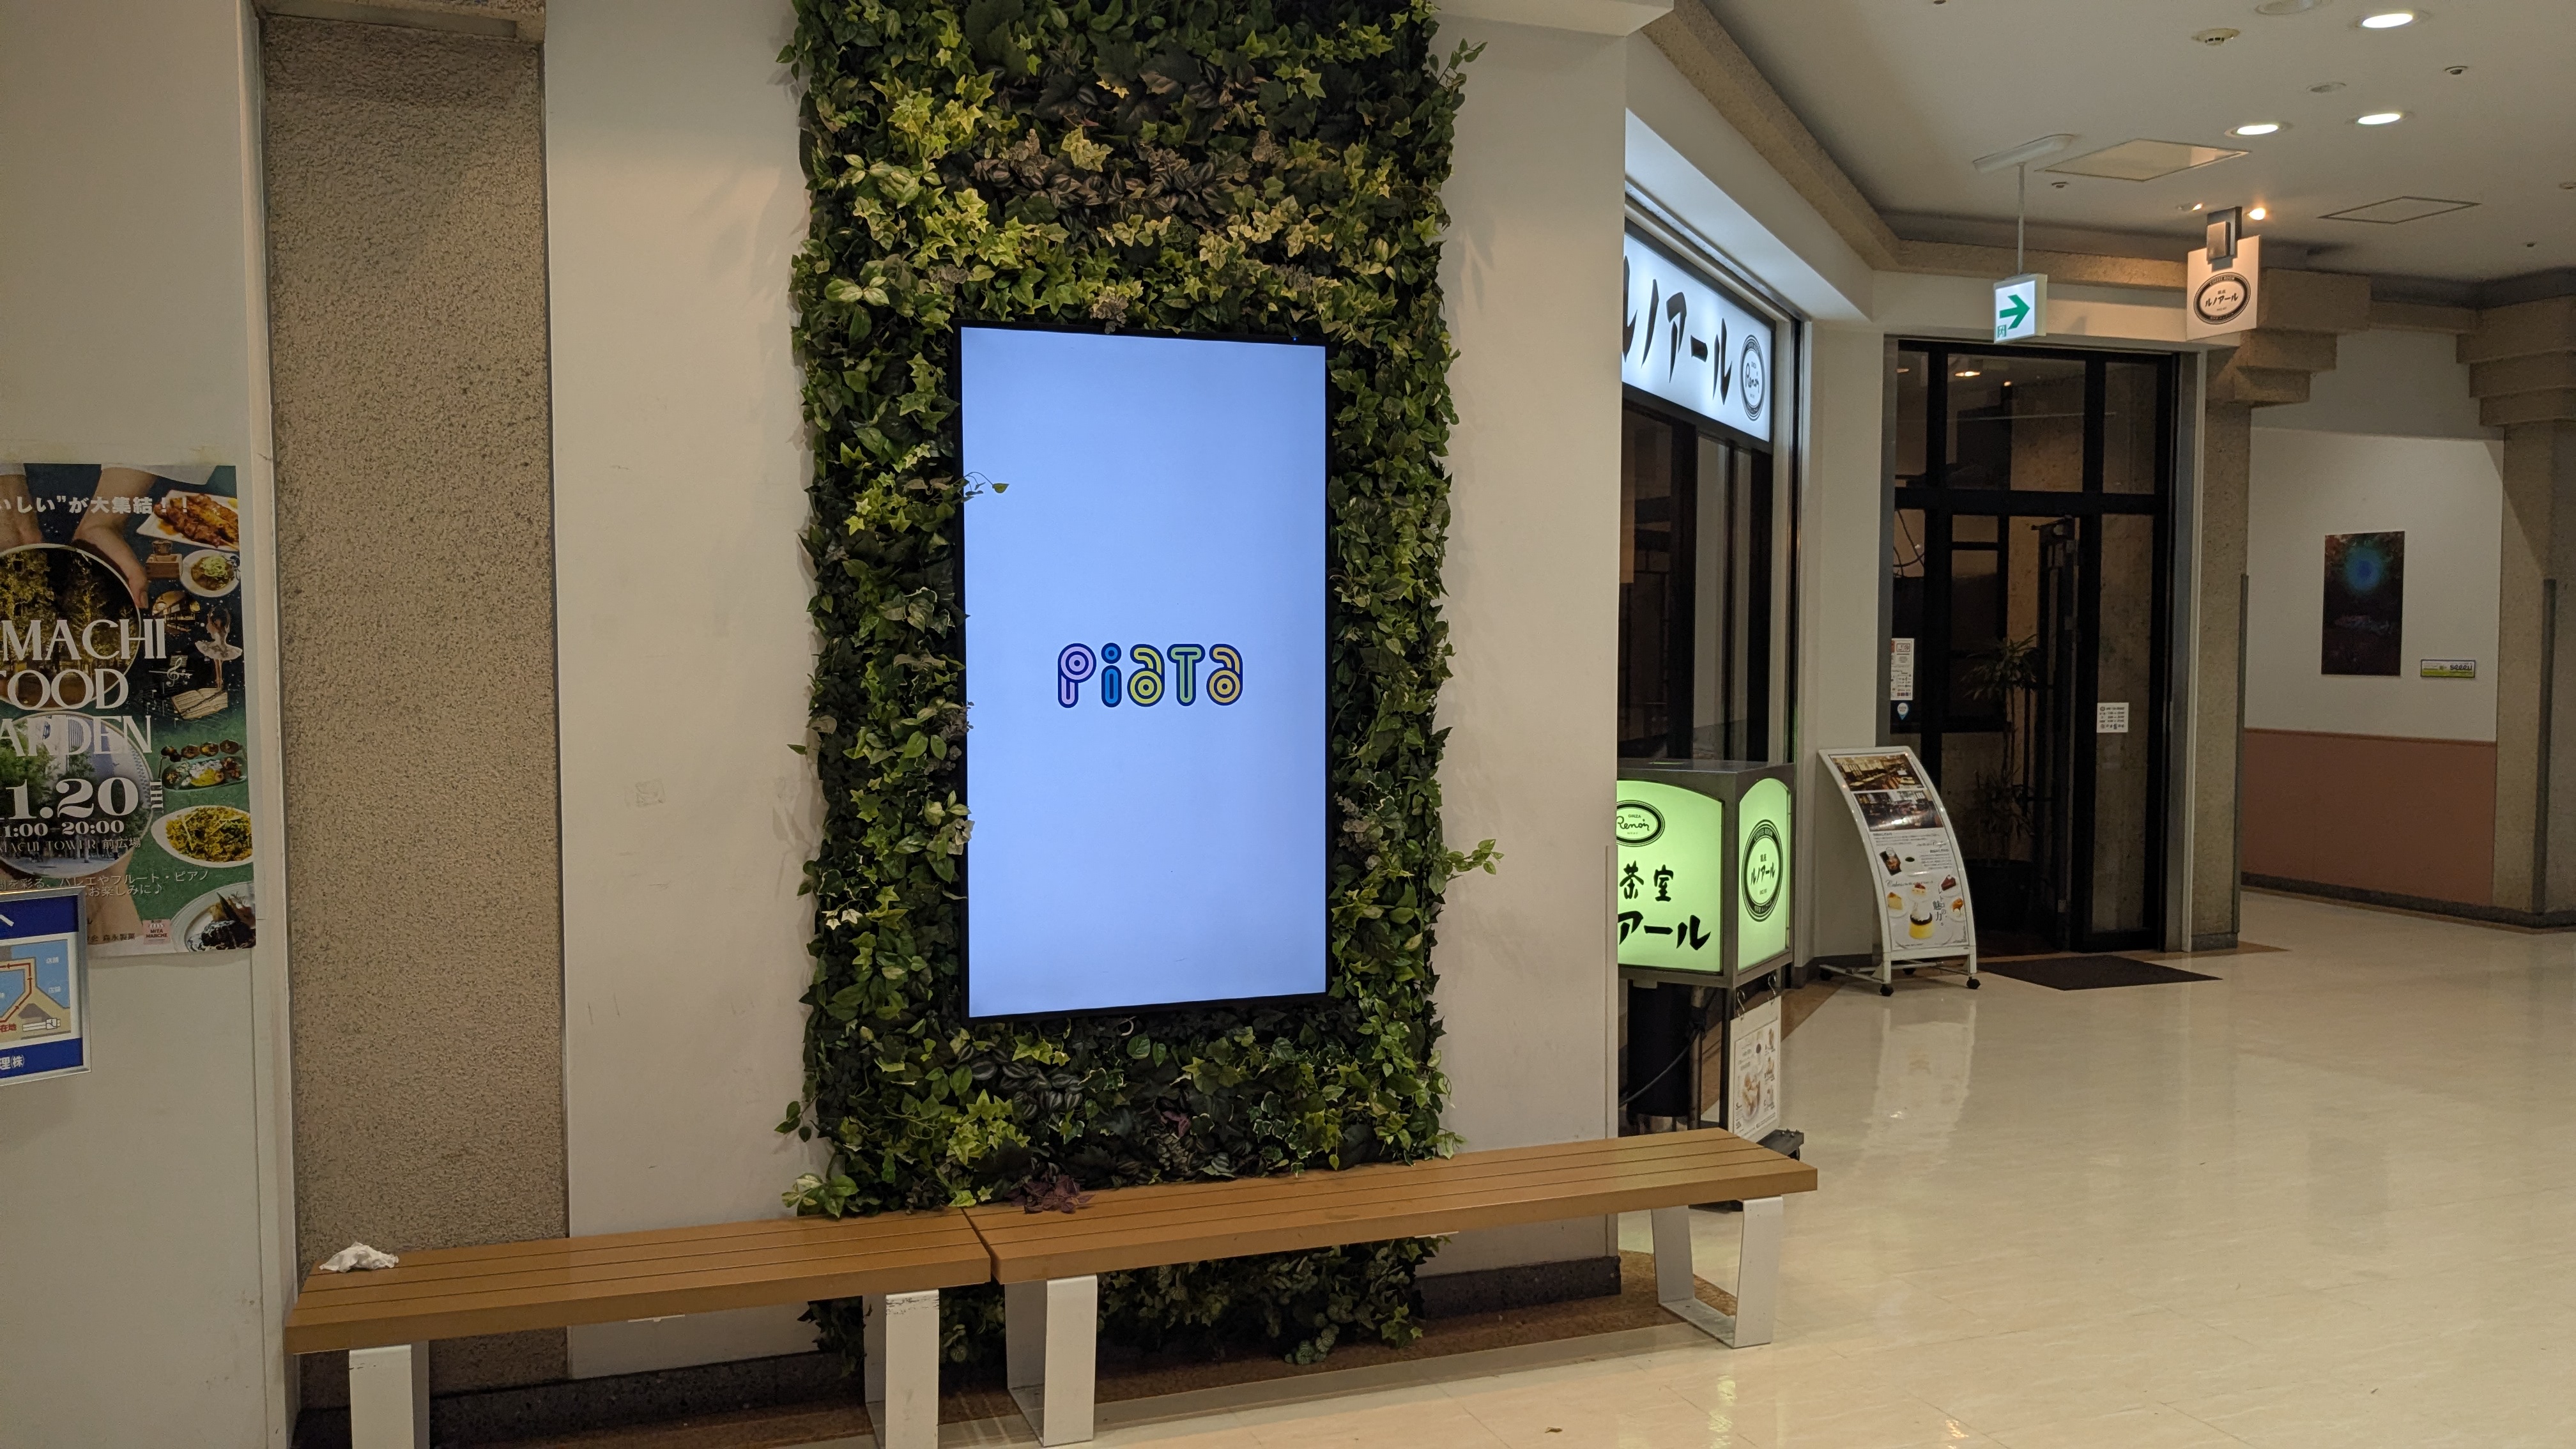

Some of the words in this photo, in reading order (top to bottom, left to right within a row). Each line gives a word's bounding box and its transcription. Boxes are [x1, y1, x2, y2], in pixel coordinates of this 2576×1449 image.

[2205, 292, 2239, 307] ルノアール
[0, 668, 128, 710] OOD
[0, 777, 139, 820] 1.20
[102, 837, 141, 850] 前広場
[1619, 859, 1675, 902] 茶室
[1751, 861, 1775, 886] ルノアール
[1618, 910, 1712, 951] アール
